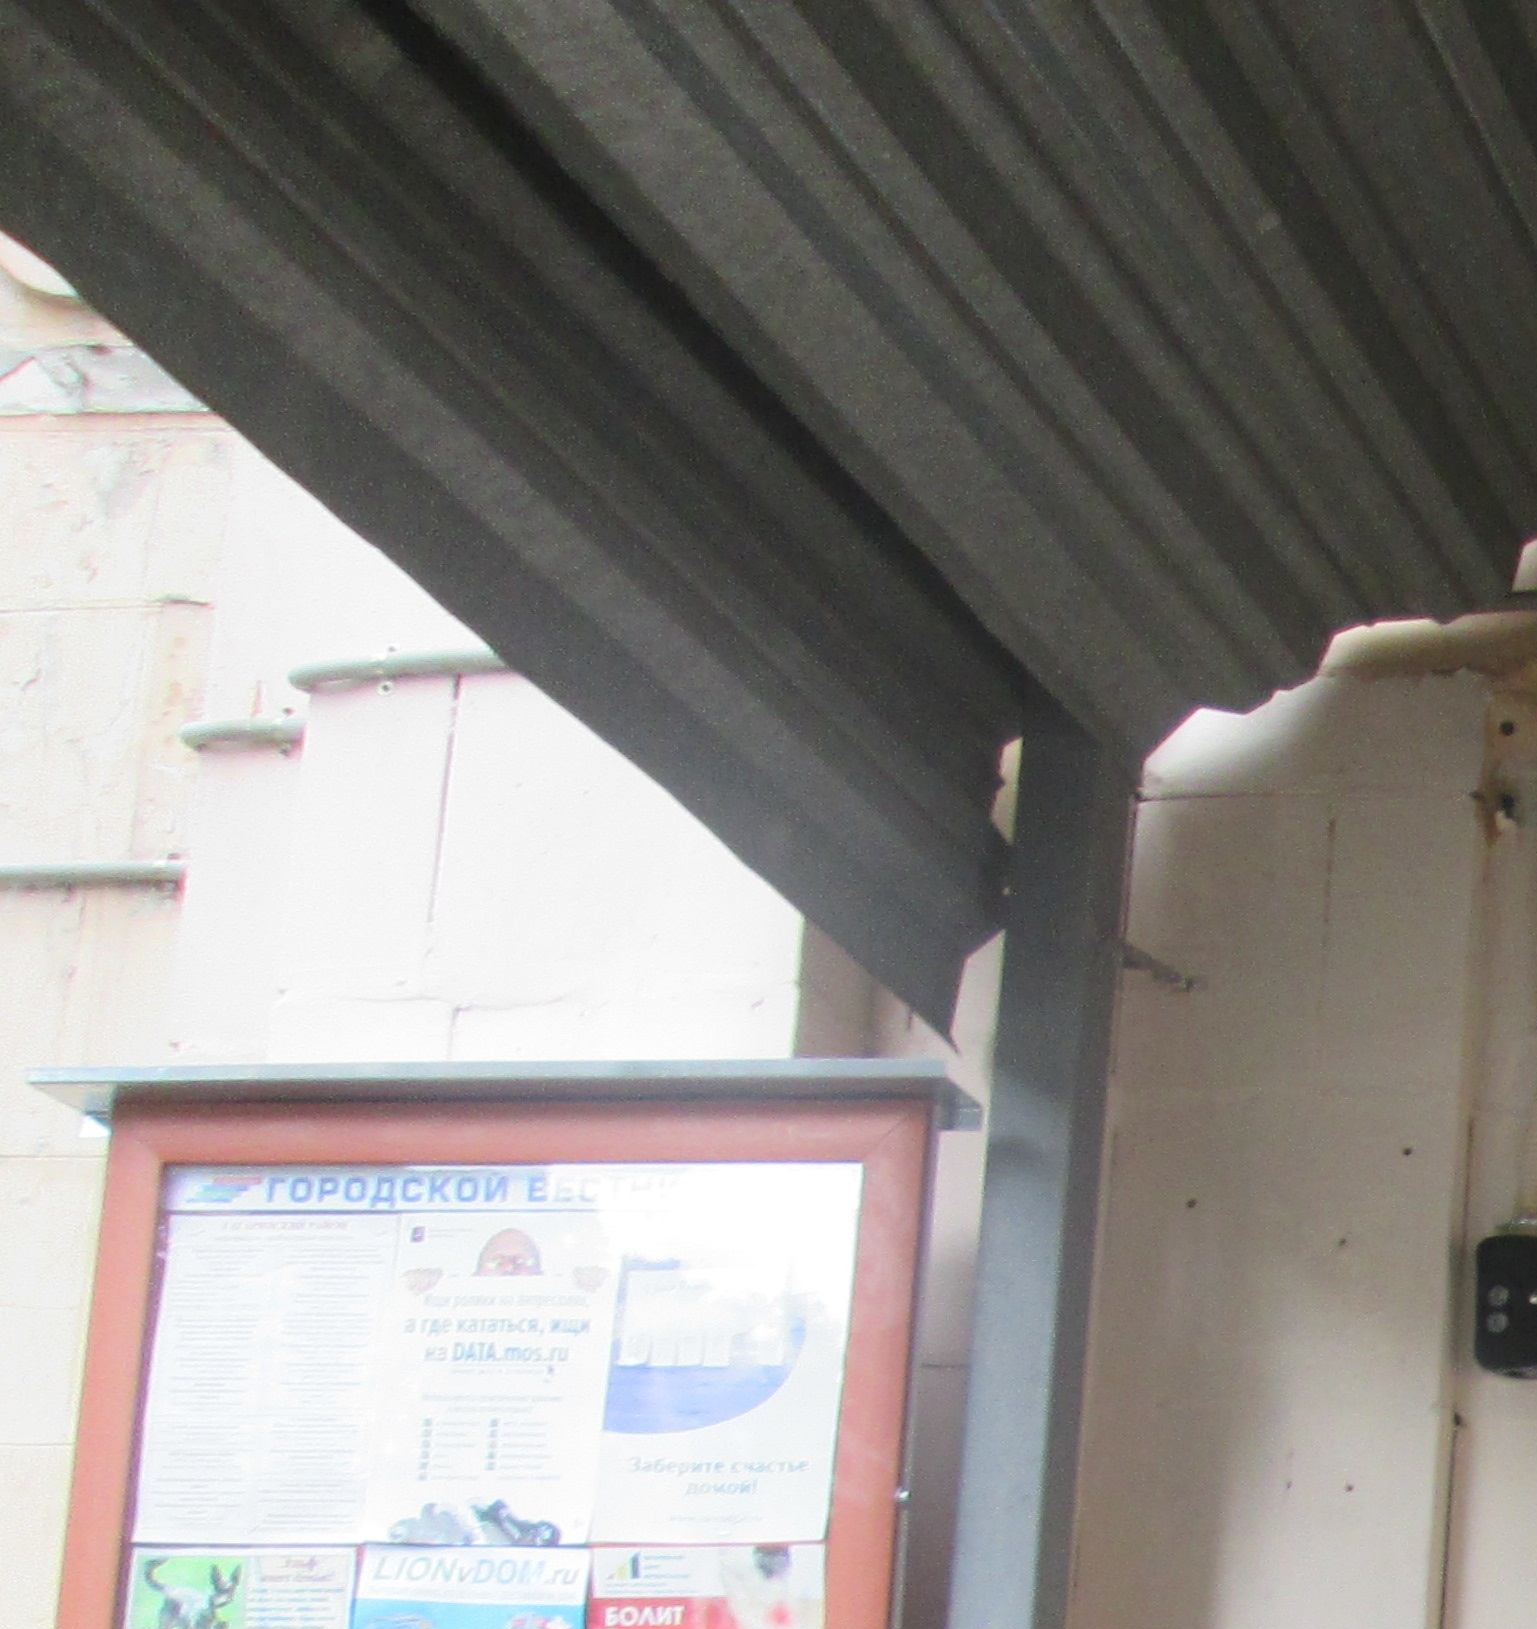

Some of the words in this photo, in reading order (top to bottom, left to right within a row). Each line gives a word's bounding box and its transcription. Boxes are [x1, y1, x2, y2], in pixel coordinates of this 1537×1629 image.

[265, 1175, 510, 1209] ГОРОДСКОЙ
[404, 1318, 416, 1333] а
[419, 1318, 452, 1337] где
[456, 1317, 545, 1337] кататься,
[452, 1341, 570, 1362] DATA.mos.ru
[628, 1456, 725, 1475] Заберите
[730, 1459, 810, 1474] счастье
[604, 1605, 686, 1627] БОЛИТ
